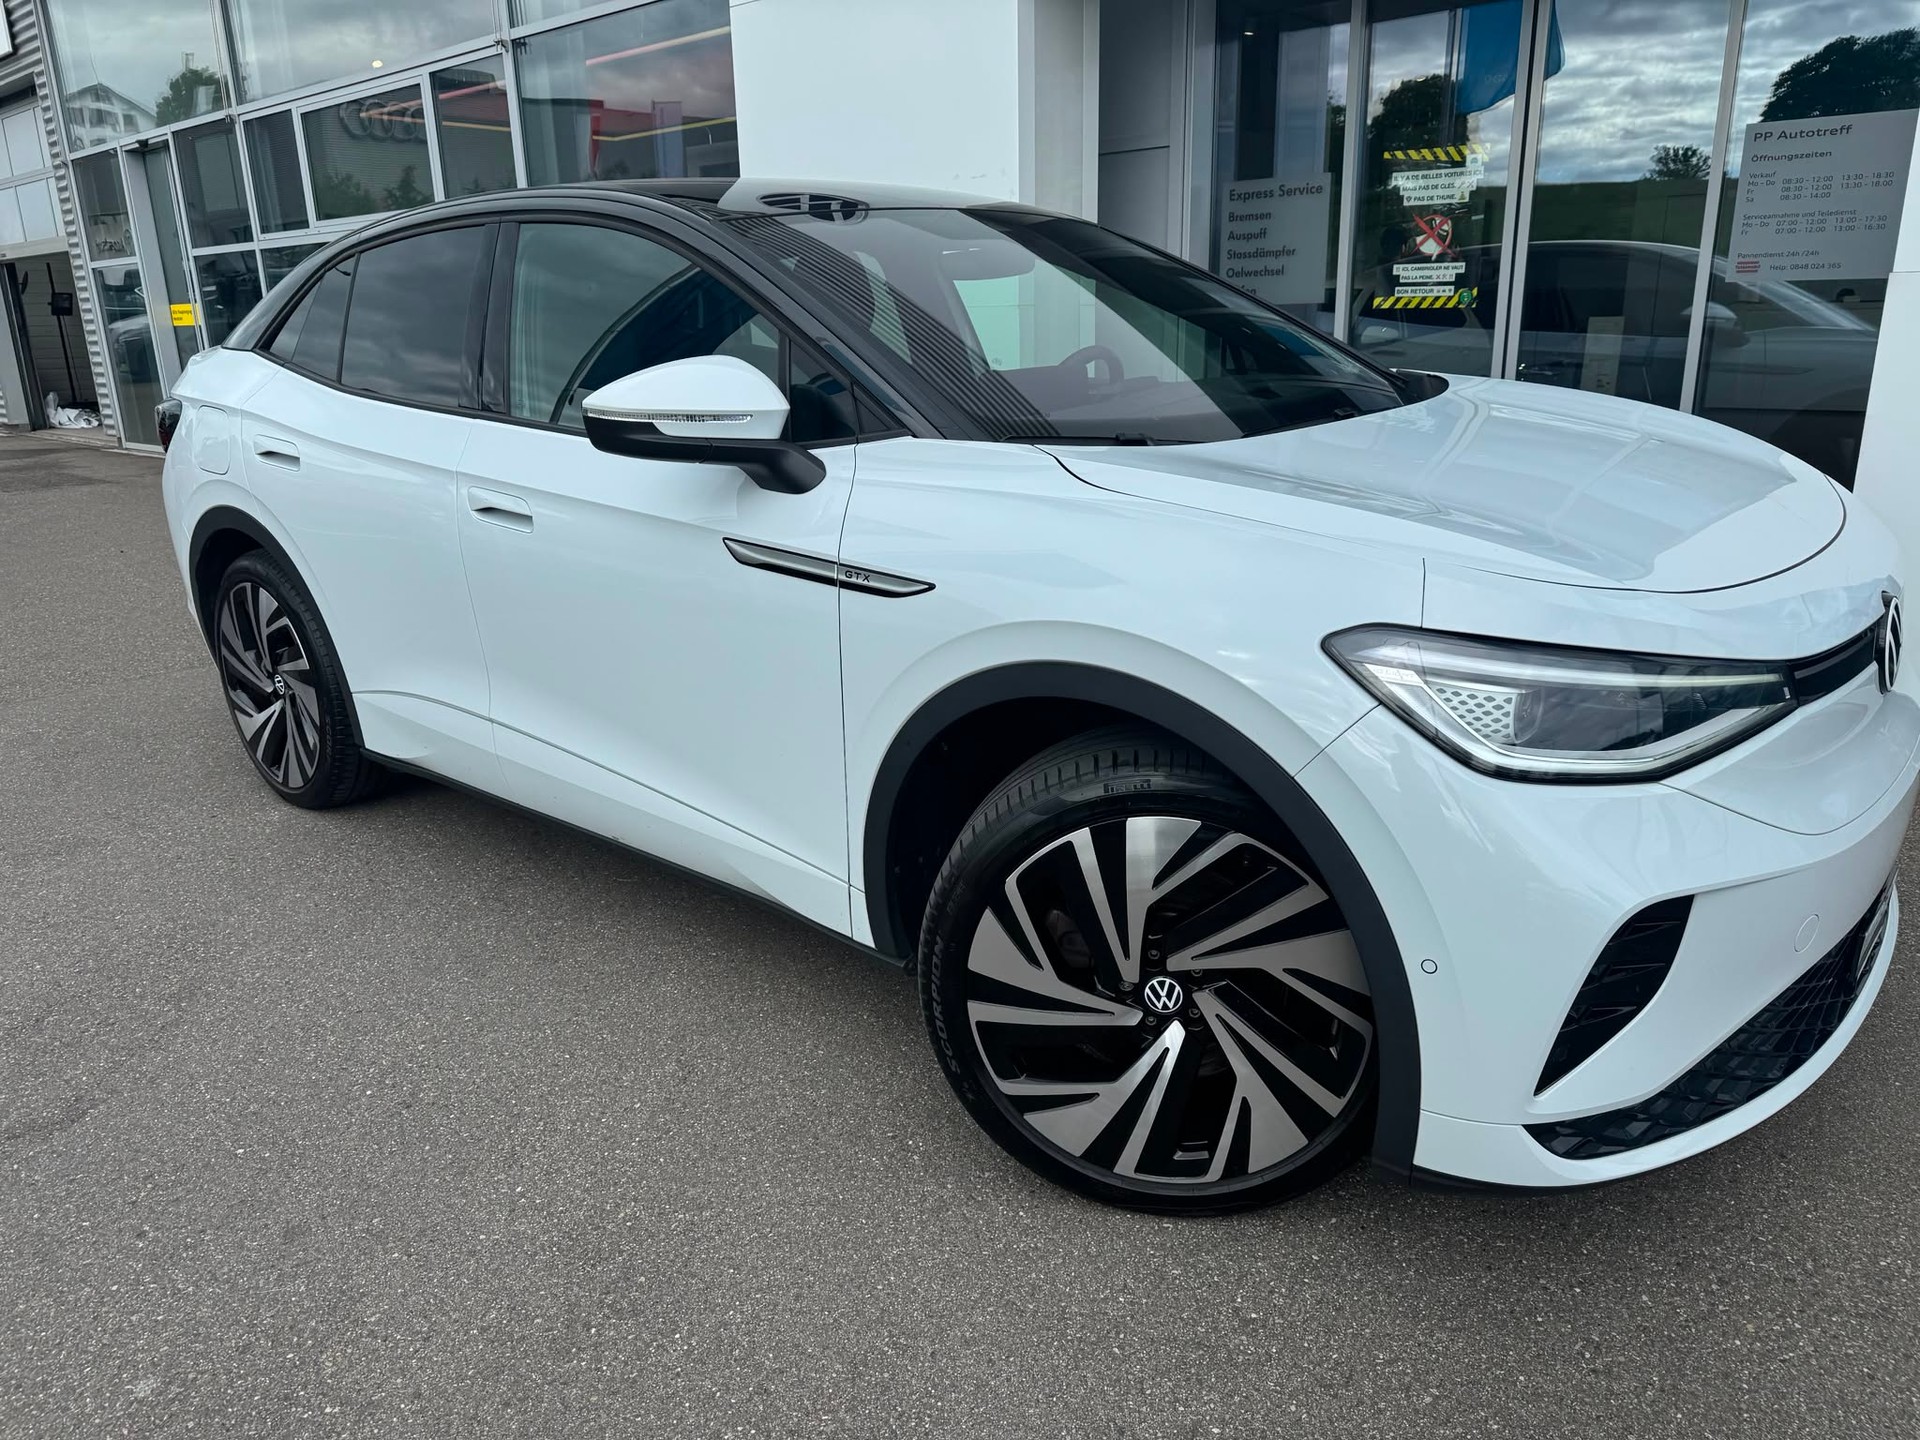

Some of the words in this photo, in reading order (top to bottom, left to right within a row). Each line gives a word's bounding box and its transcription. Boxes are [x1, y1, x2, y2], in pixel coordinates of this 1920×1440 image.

[1754, 131, 1773, 142] PP
[1776, 124, 1853, 141] Autotreff
[1751, 150, 1832, 163] Öffnungszeiten
[1229, 189, 1274, 203] Express
[1278, 183, 1323, 197] Service
[1228, 211, 1272, 222] Bremsen
[1227, 228, 1268, 242] Auspuff
[1226, 245, 1296, 260] Stossdämpfer
[1226, 264, 1285, 278] Oelwechsel
[845, 570, 870, 583] GTX
[1144, 978, 1183, 1012] VW
[931, 934, 961, 1075] SCORPION
